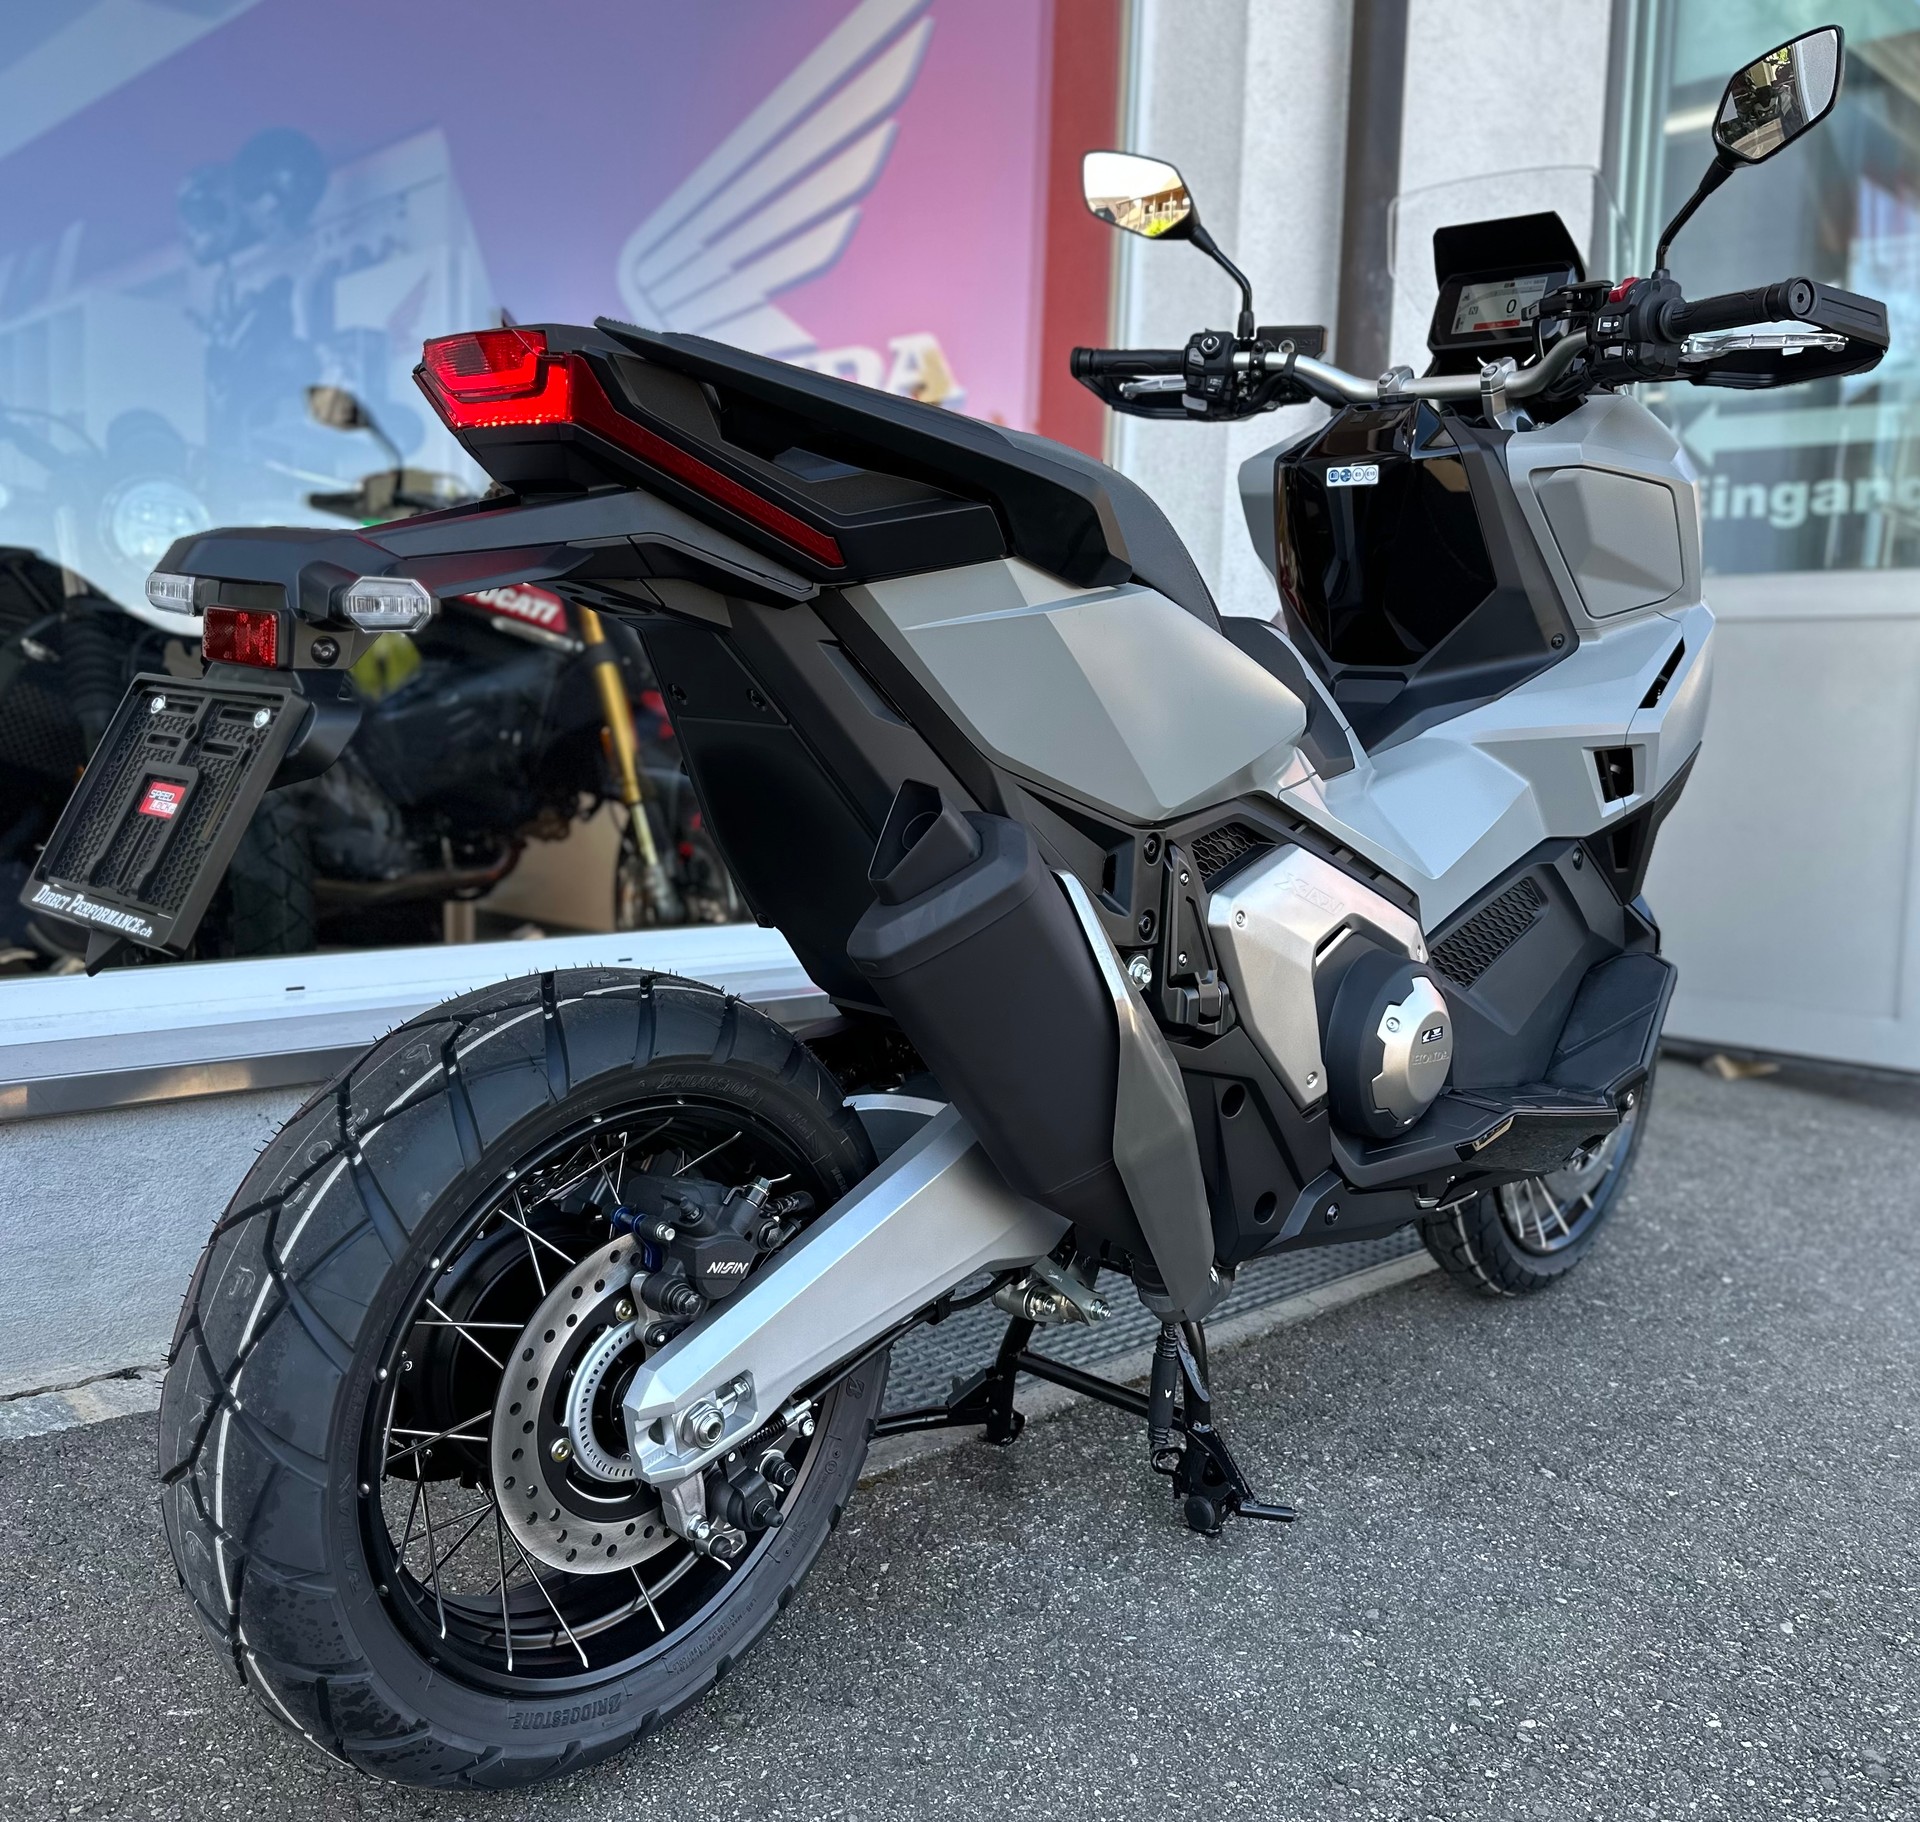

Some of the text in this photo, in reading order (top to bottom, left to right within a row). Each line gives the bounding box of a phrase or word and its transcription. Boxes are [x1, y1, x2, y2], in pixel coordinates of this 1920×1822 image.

[1506, 299, 1517, 314] 0
[149, 789, 175, 802] SPEED
[31, 884, 153, 938] DIRECT PERFORMANCE.ch
[511, 1692, 621, 1730] BRIDGESTONE
